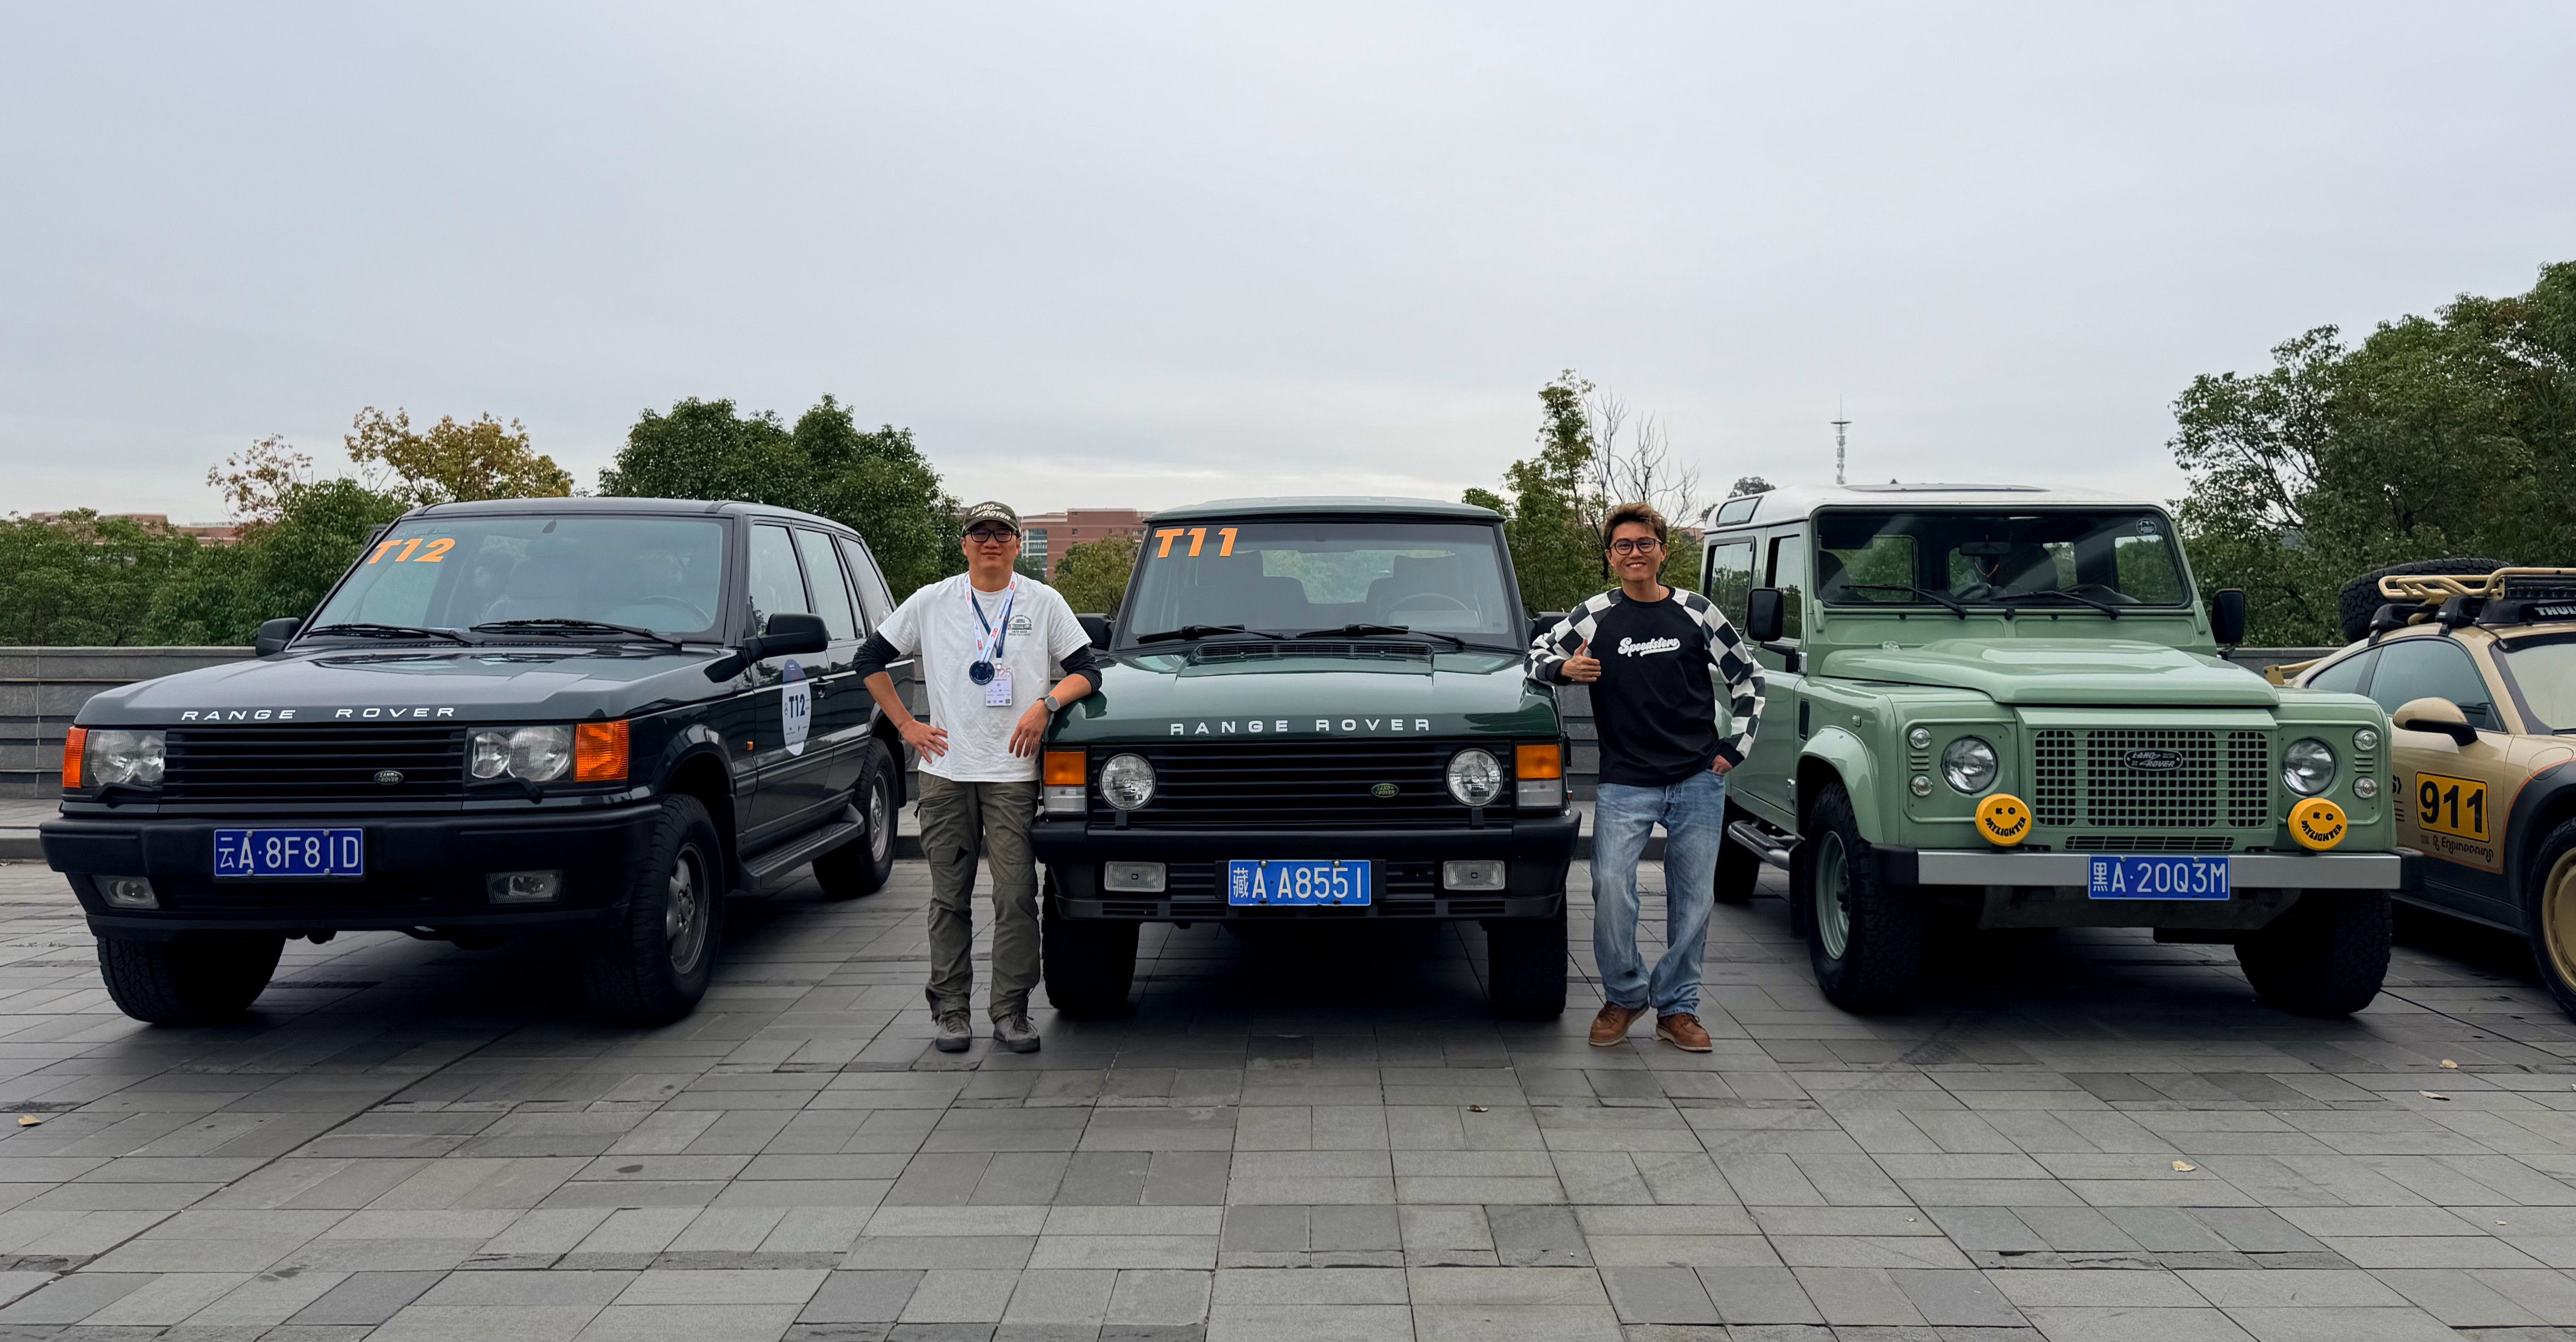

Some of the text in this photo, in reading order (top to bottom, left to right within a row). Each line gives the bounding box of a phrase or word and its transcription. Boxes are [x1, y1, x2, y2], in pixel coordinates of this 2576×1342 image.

[970, 504, 1001, 515] LAND
[976, 510, 1011, 521] ROVER
[367, 538, 455, 564] T12
[1155, 528, 1238, 558] T11
[2534, 606, 2576, 616] THUL
[182, 707, 455, 720] RANGE ROVER
[789, 694, 805, 718] T12
[1170, 719, 1429, 735] RANGE ROVER
[2420, 781, 2484, 833] 911
[1985, 816, 2026, 837] DAYLIGHTER
[2301, 820, 2343, 842] DAYLIGHTER
